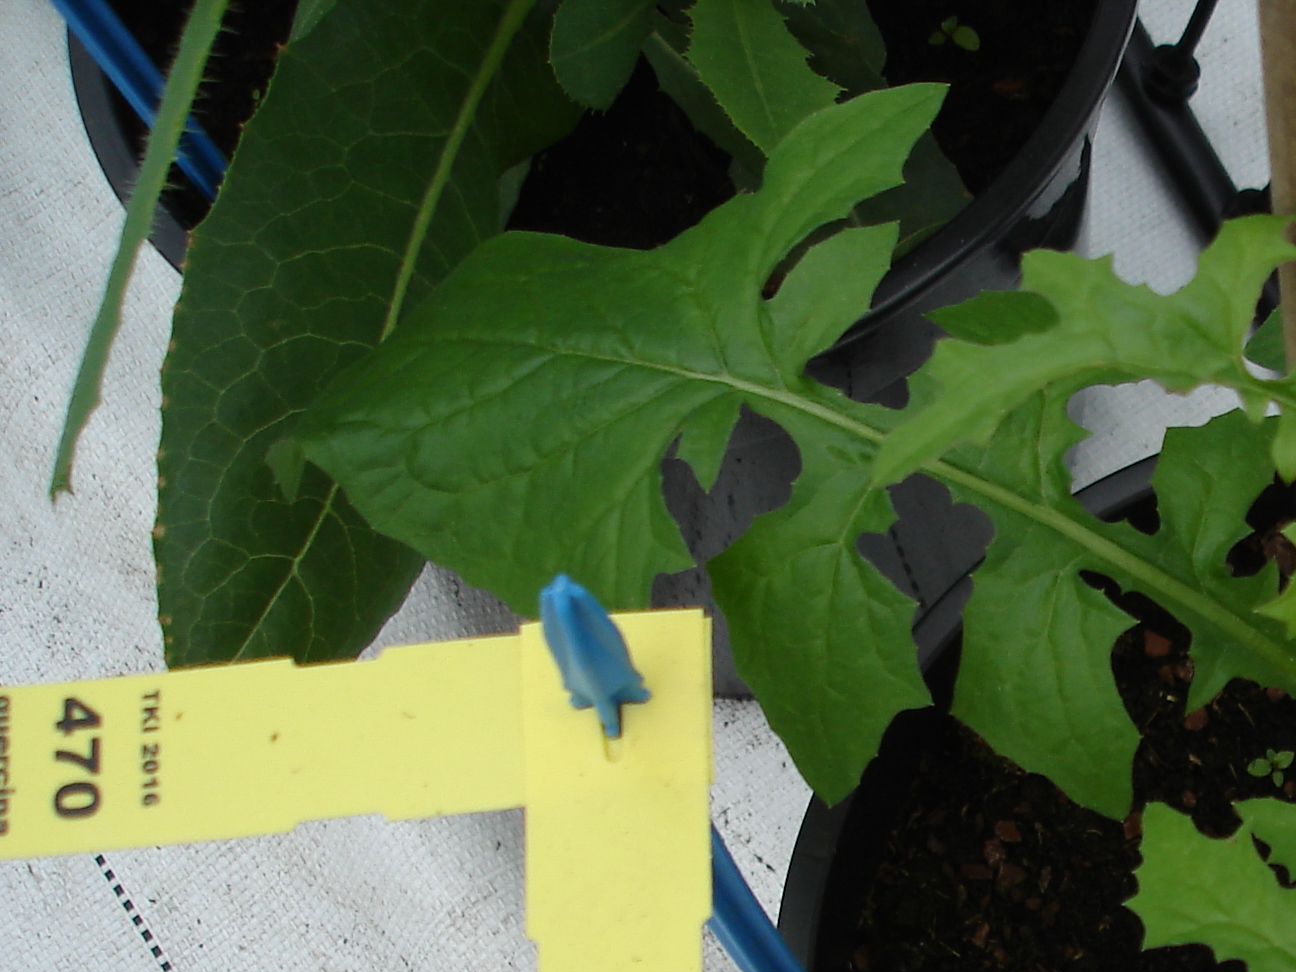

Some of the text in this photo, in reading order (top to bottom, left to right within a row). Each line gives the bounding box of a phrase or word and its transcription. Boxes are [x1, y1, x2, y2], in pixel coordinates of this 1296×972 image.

[54, 697, 102, 820] 470
[142, 690, 160, 806] TKI 2016
